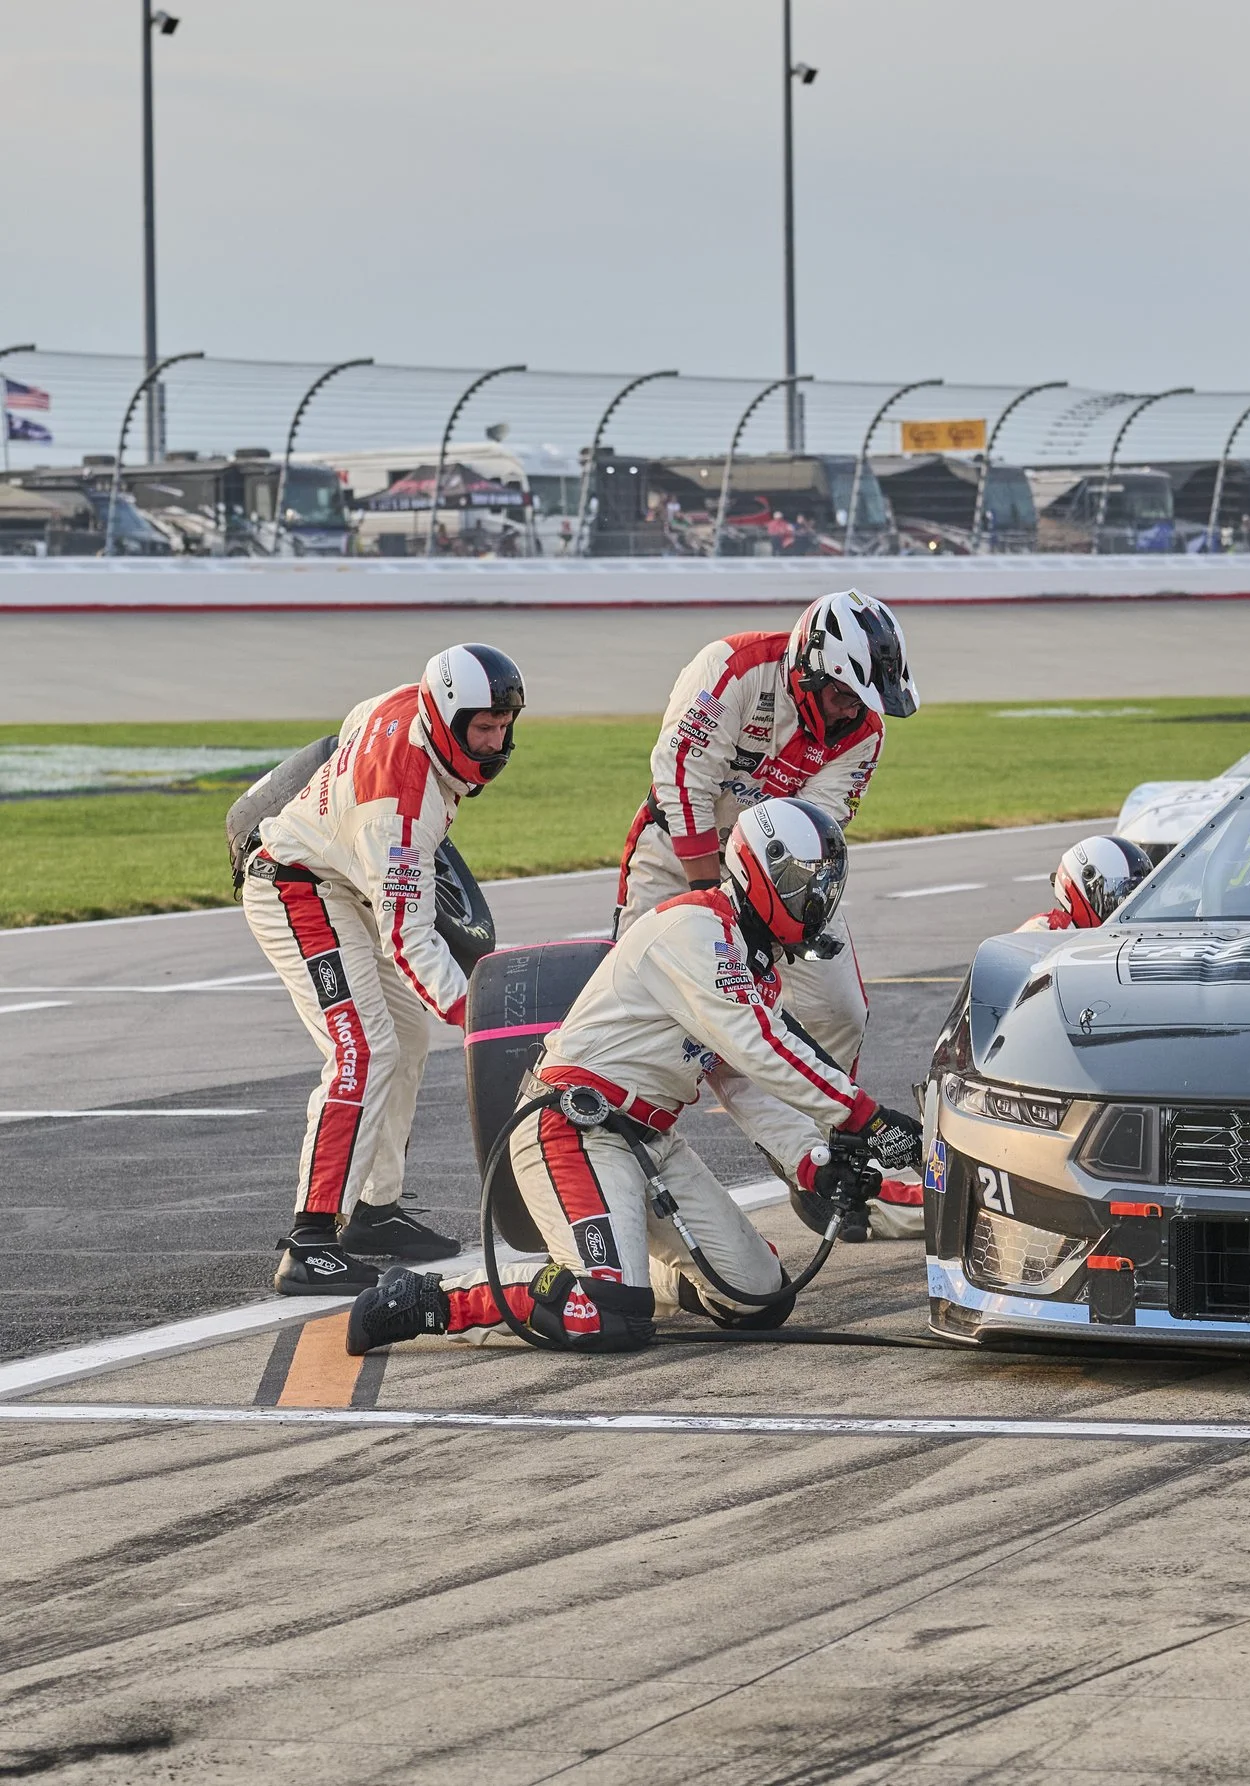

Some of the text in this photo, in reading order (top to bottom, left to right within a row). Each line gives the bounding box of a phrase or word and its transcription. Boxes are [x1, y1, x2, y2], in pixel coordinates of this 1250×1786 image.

[687, 707, 718, 729] FORD
[678, 720, 707, 740] LINCOLN
[679, 731, 706, 747] WELDERS
[670, 737, 703, 758] eero
[387, 867, 421, 877] FORD
[383, 883, 415, 891] LINCOLN
[382, 900, 418, 913] eero
[717, 962, 747, 970] FORD
[716, 976, 749, 987] LINCOLN
[769, 989, 777, 1000] 21
[877, 1133, 917, 1158] Mechanix
[978, 1166, 1015, 1216] 21
[306, 1256, 336, 1270] sparco
